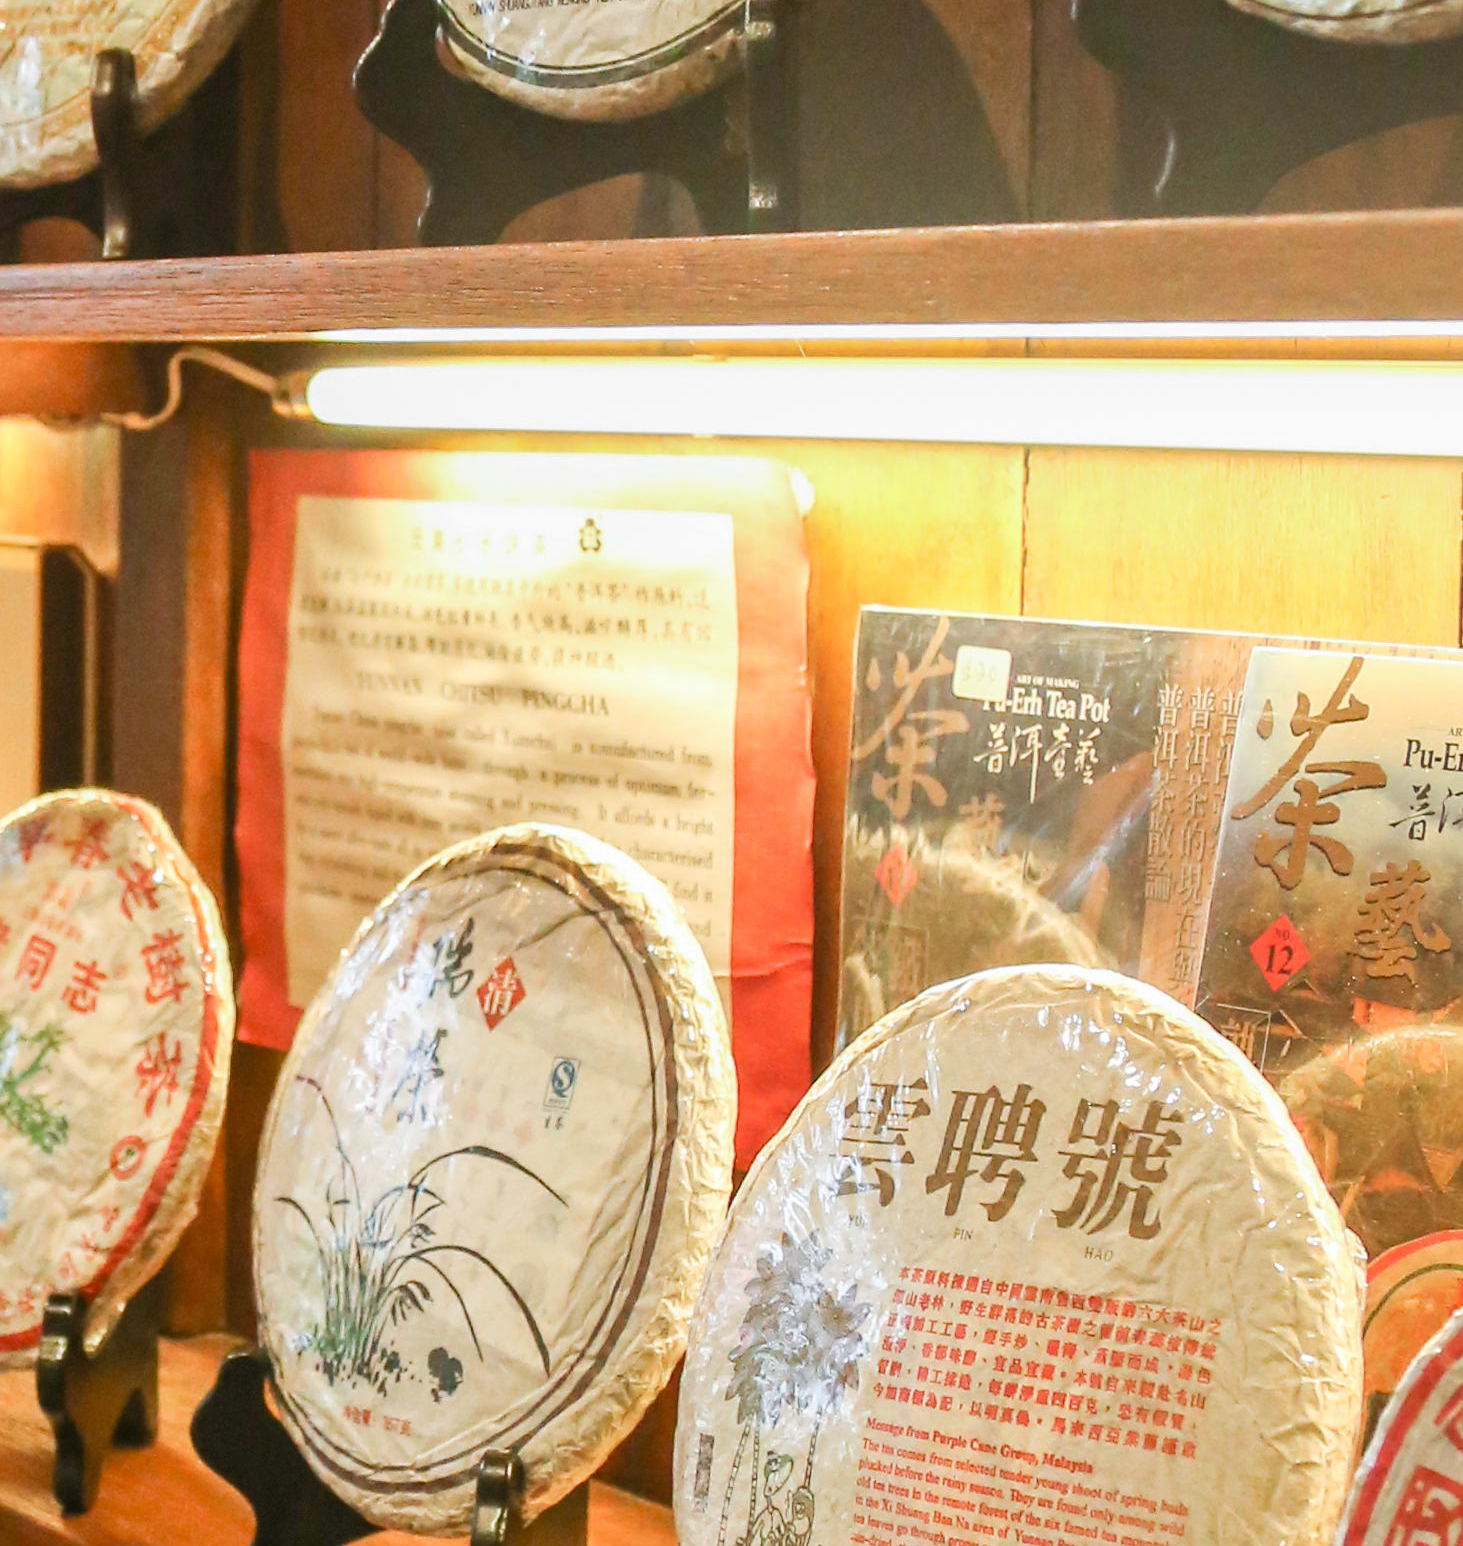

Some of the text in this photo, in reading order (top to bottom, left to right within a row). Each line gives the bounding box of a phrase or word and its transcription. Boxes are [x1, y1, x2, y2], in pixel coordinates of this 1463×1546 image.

[1046, 690, 1077, 720] Tea
[1079, 694, 1111, 724] Pot
[1265, 944, 1295, 977] 12
[952, 1227, 973, 1241] PIN
[1083, 1245, 1114, 1262] HAO
